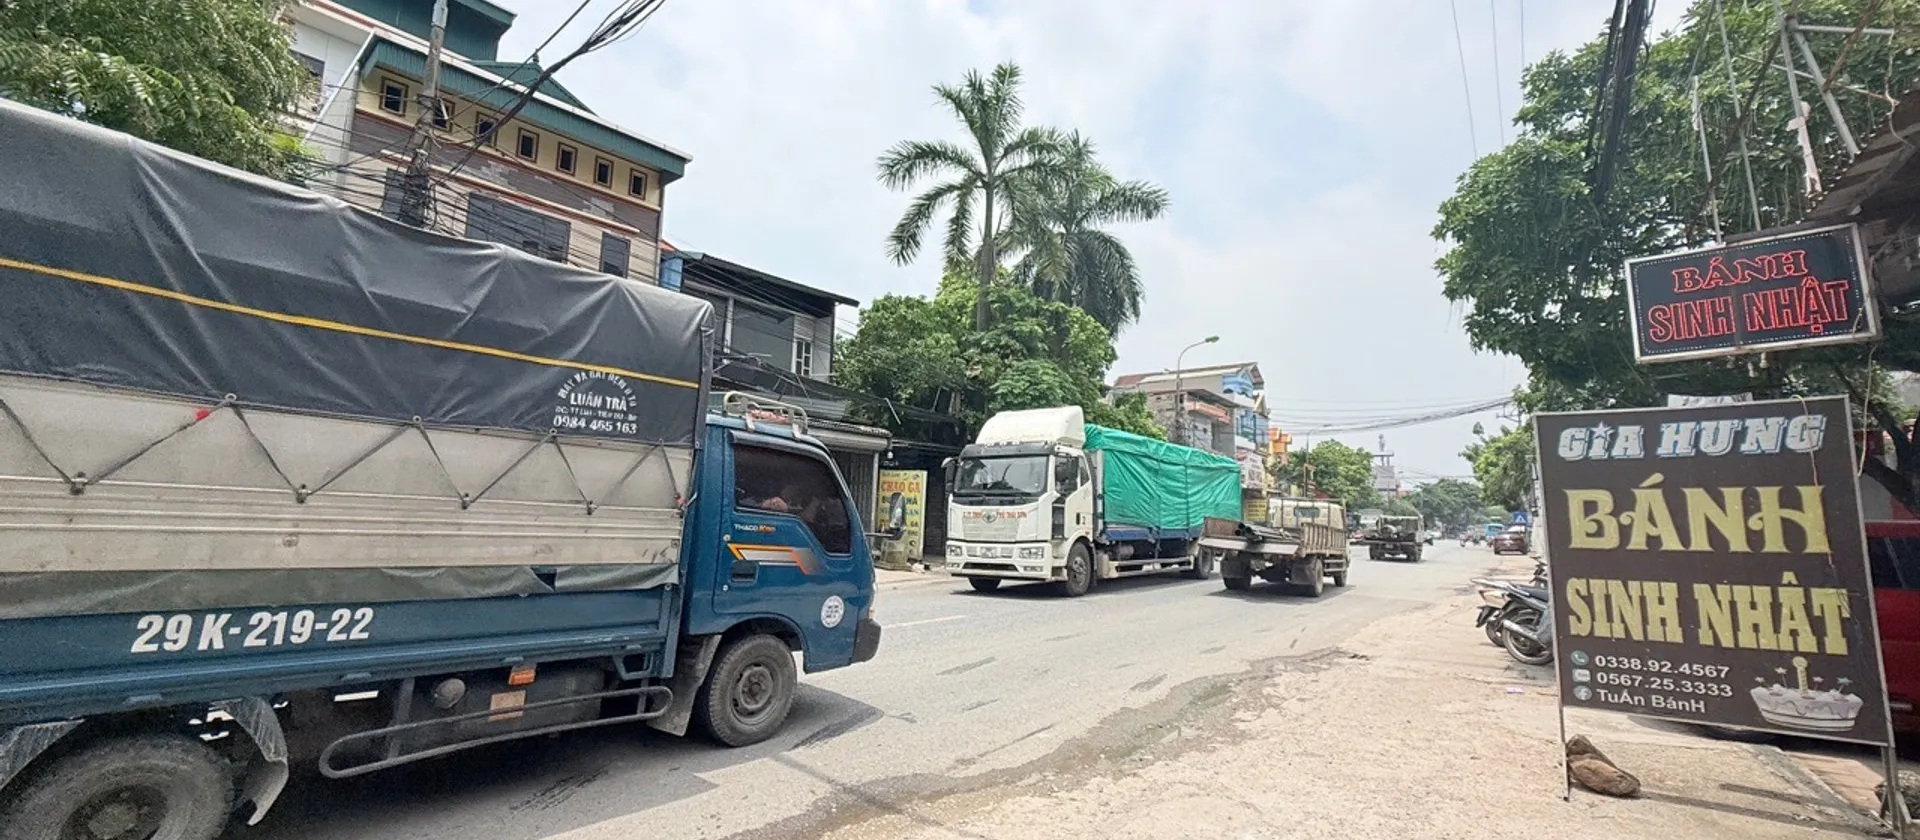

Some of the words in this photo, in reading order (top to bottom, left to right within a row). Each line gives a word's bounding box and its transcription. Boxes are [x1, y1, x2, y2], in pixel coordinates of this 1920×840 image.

[1672, 250, 1808, 292] BÁNH
[1649, 296, 1736, 343] SINH
[1743, 275, 1849, 333] NHẬT
[616, 421, 638, 434] 163
[1563, 472, 1832, 553] BÁNH
[131, 614, 192, 653] 29
[197, 607, 374, 650] K-219-22
[1566, 578, 1684, 643] SINH
[1595, 655, 1730, 678] 0338.92.4567
[1596, 672, 1733, 697] 0567.25.3333
